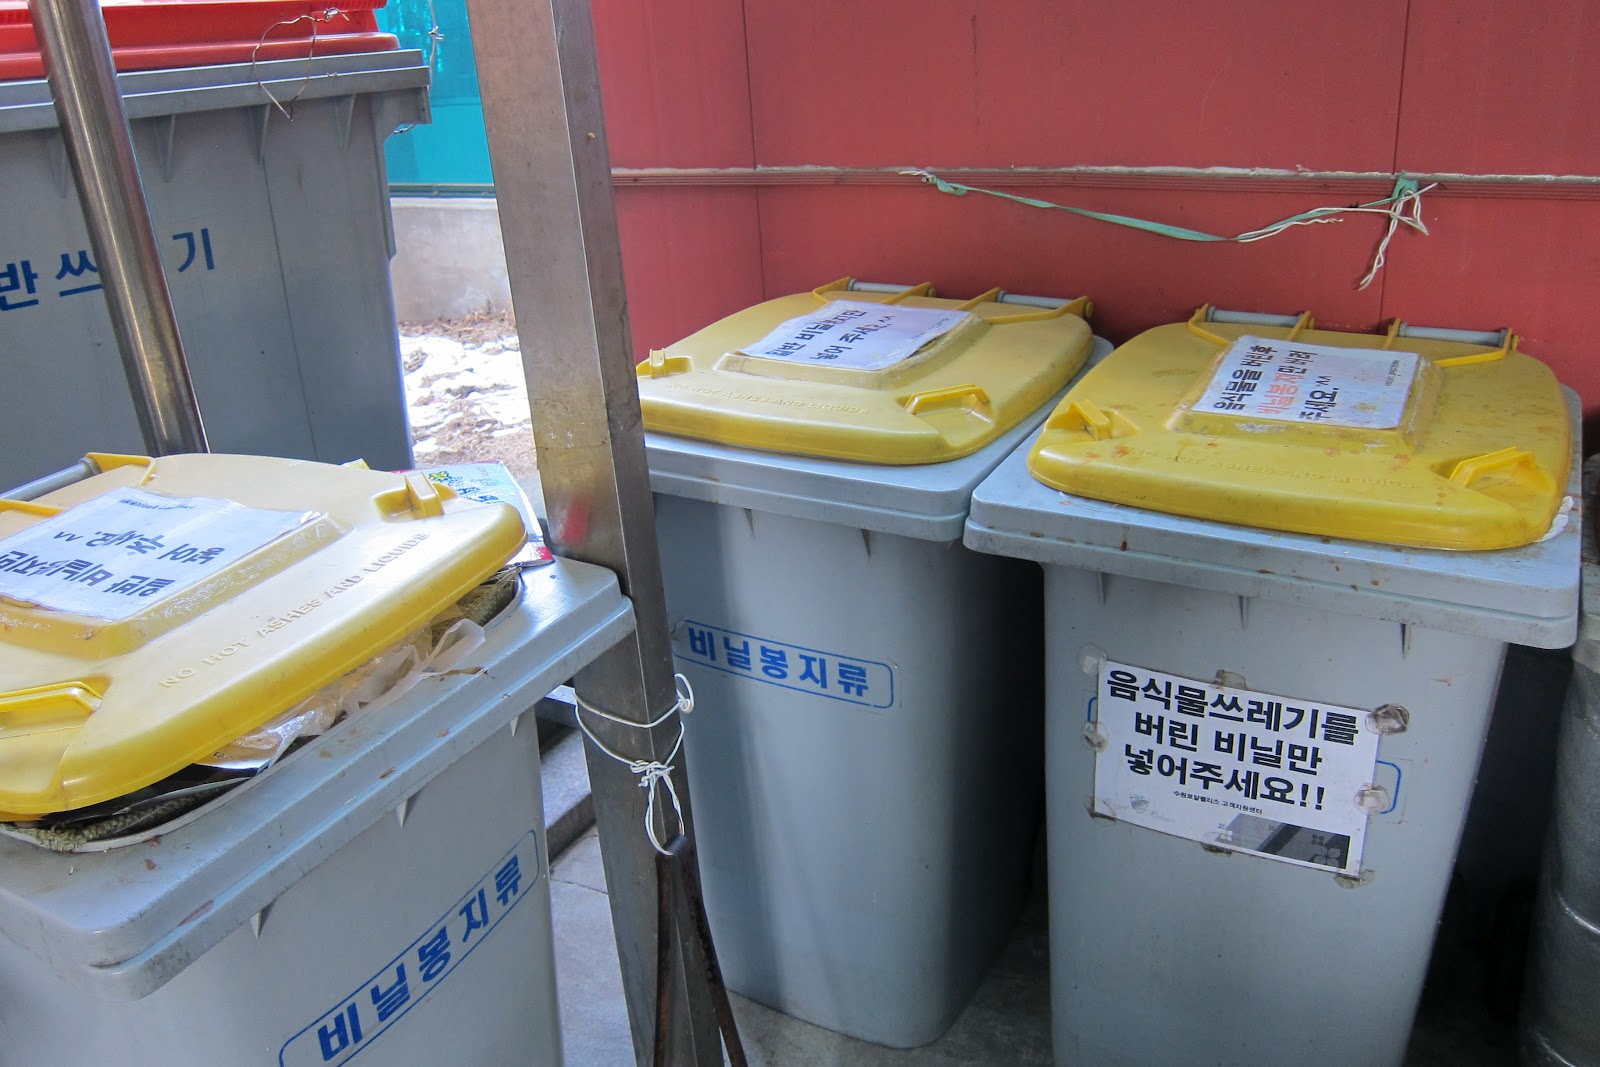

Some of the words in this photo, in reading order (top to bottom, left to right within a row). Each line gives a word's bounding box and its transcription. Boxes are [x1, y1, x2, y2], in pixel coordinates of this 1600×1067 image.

[692, 387, 721, 396] HOT
[722, 391, 769, 403] ASHES
[772, 399, 804, 407] AND
[807, 402, 870, 415] LIQUIDS
[1213, 368, 1263, 411] 음식물을
[1256, 365, 1309, 414] 비닐봉지만
[157, 543, 225, 565] 넣어
[159, 668, 196, 688] NO
[202, 638, 250, 666] HOT
[257, 598, 323, 638] ASHES
[324, 574, 363, 598] AND
[362, 532, 430, 573] LIQUIDS
[688, 627, 869, 697] 비닐봉지류
[1107, 669, 1359, 745] 음식물쓰레기를
[1135, 712, 1199, 753] 버린
[1214, 731, 1322, 775] 비닐만
[1125, 744, 1324, 810] 넣어주세요!!
[317, 855, 521, 1061] 비닐봉지류
